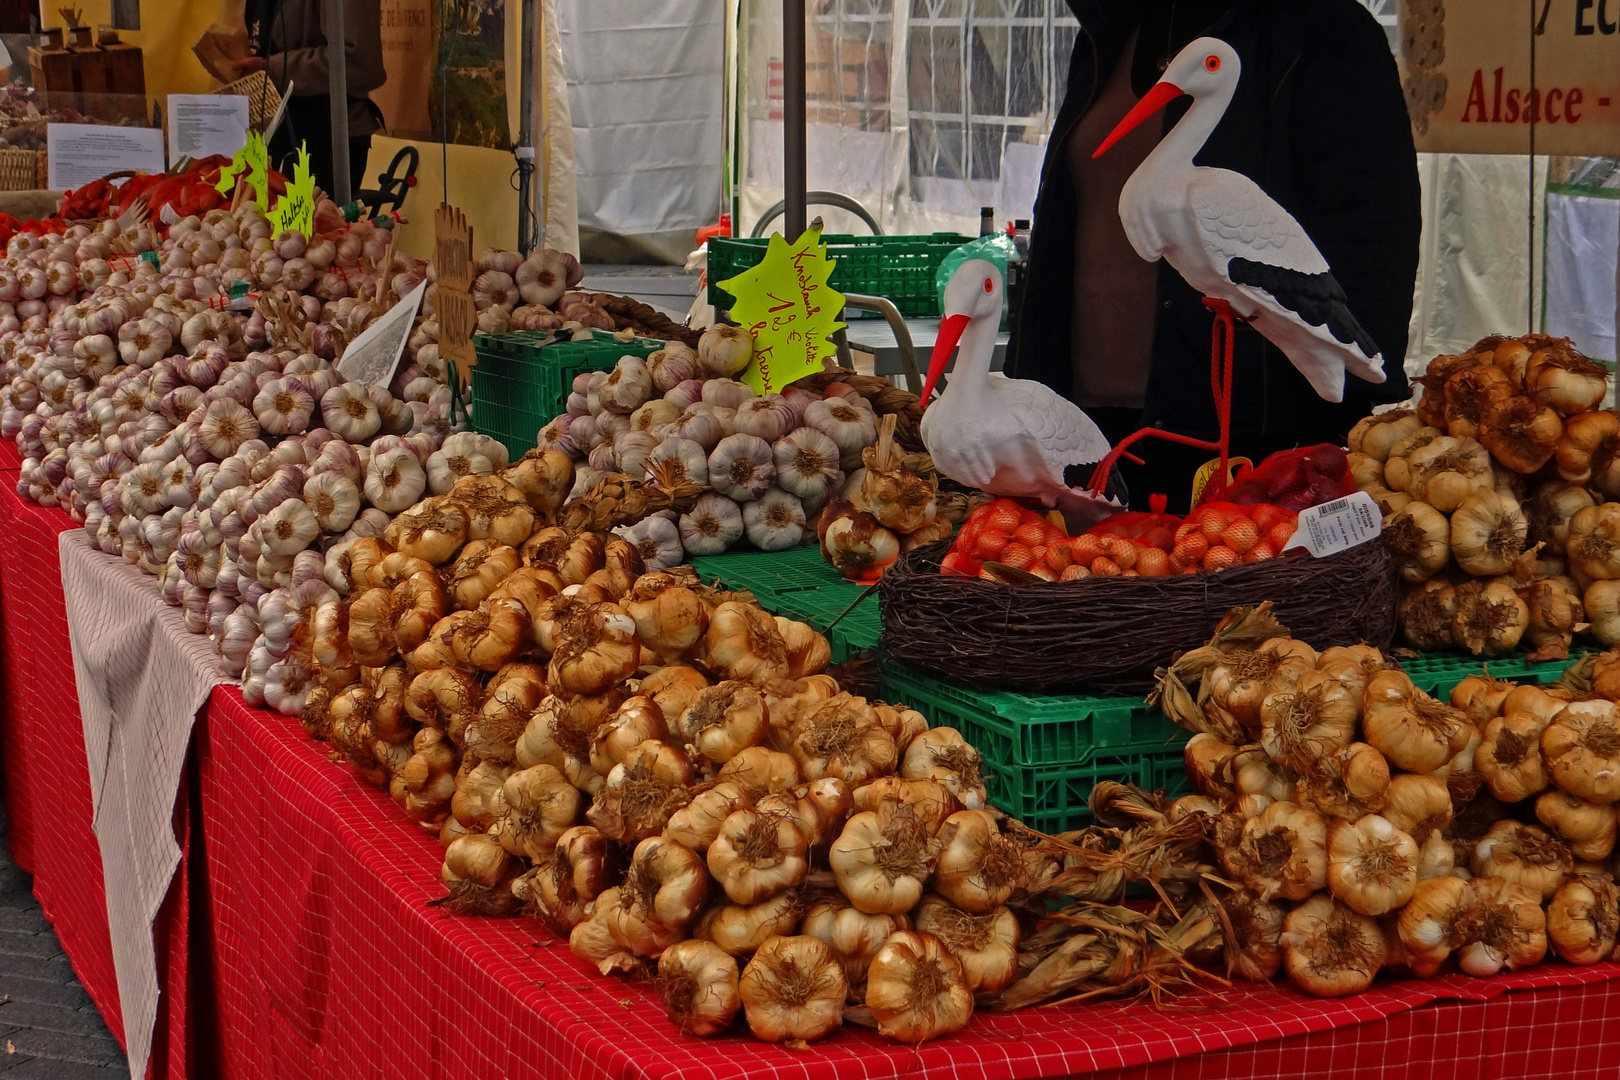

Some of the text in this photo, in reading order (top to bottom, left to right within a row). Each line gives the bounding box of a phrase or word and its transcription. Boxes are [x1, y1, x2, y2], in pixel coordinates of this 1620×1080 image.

[1574, 0, 1620, 36] EC
[1460, 66, 1584, 125] Alsace
[766, 291, 797, 332] 12
[789, 245, 822, 366] Knoblauch Violette
[748, 320, 774, 395] la tresse
